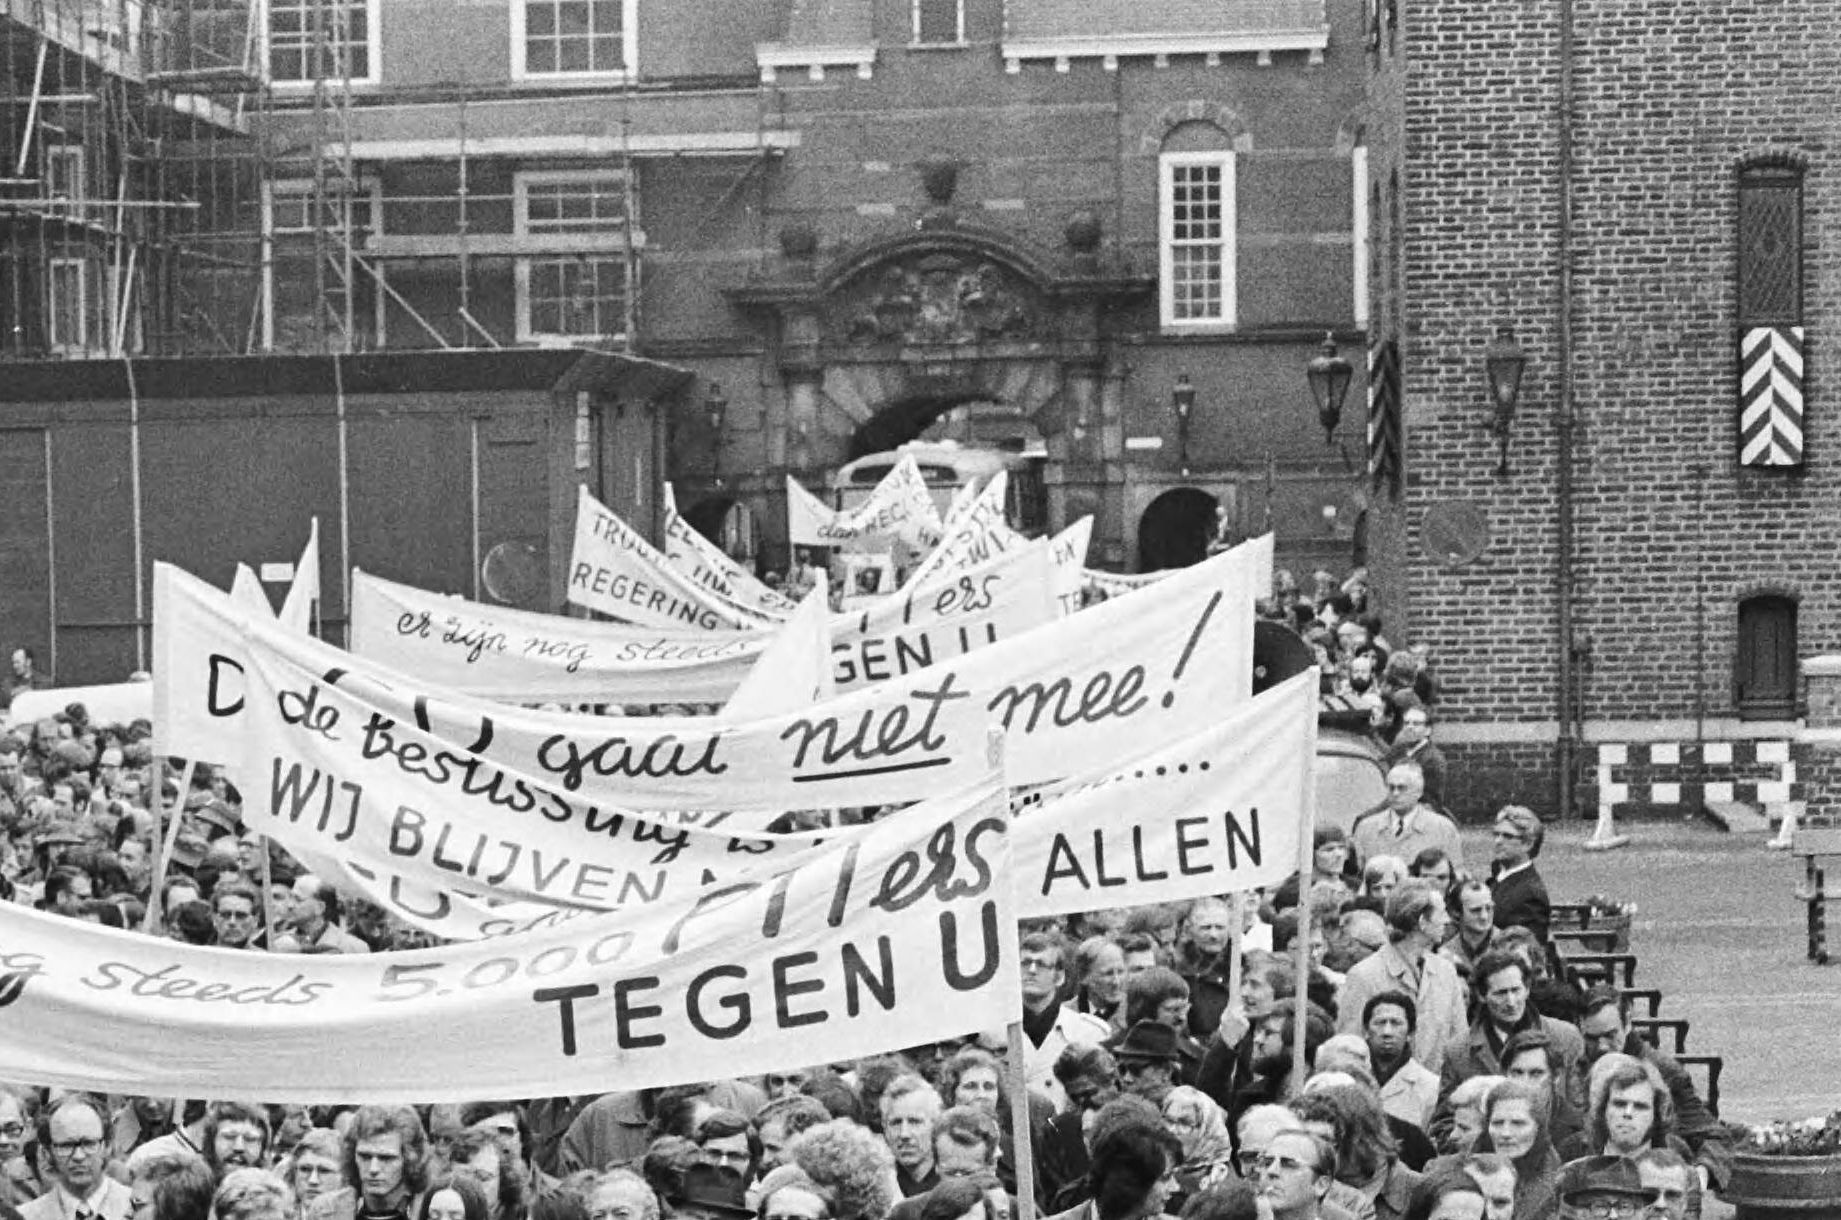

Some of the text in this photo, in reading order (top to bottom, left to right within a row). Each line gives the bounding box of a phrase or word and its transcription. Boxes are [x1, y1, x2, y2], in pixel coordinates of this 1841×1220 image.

[572, 562, 719, 631] REGERING
[397, 608, 431, 638] er
[442, 619, 508, 662] zijn
[524, 636, 594, 673] nog
[832, 632, 933, 684] GEN
[987, 590, 1223, 733] mee!
[277, 685, 341, 742] de
[270, 756, 363, 841] WIJ
[388, 804, 665, 904] BLIJVEN
[1041, 807, 1262, 896] ALLEN
[80, 957, 336, 1007] steeds
[379, 929, 635, 1002] 5.000
[532, 899, 1001, 1057] TEGEN U
